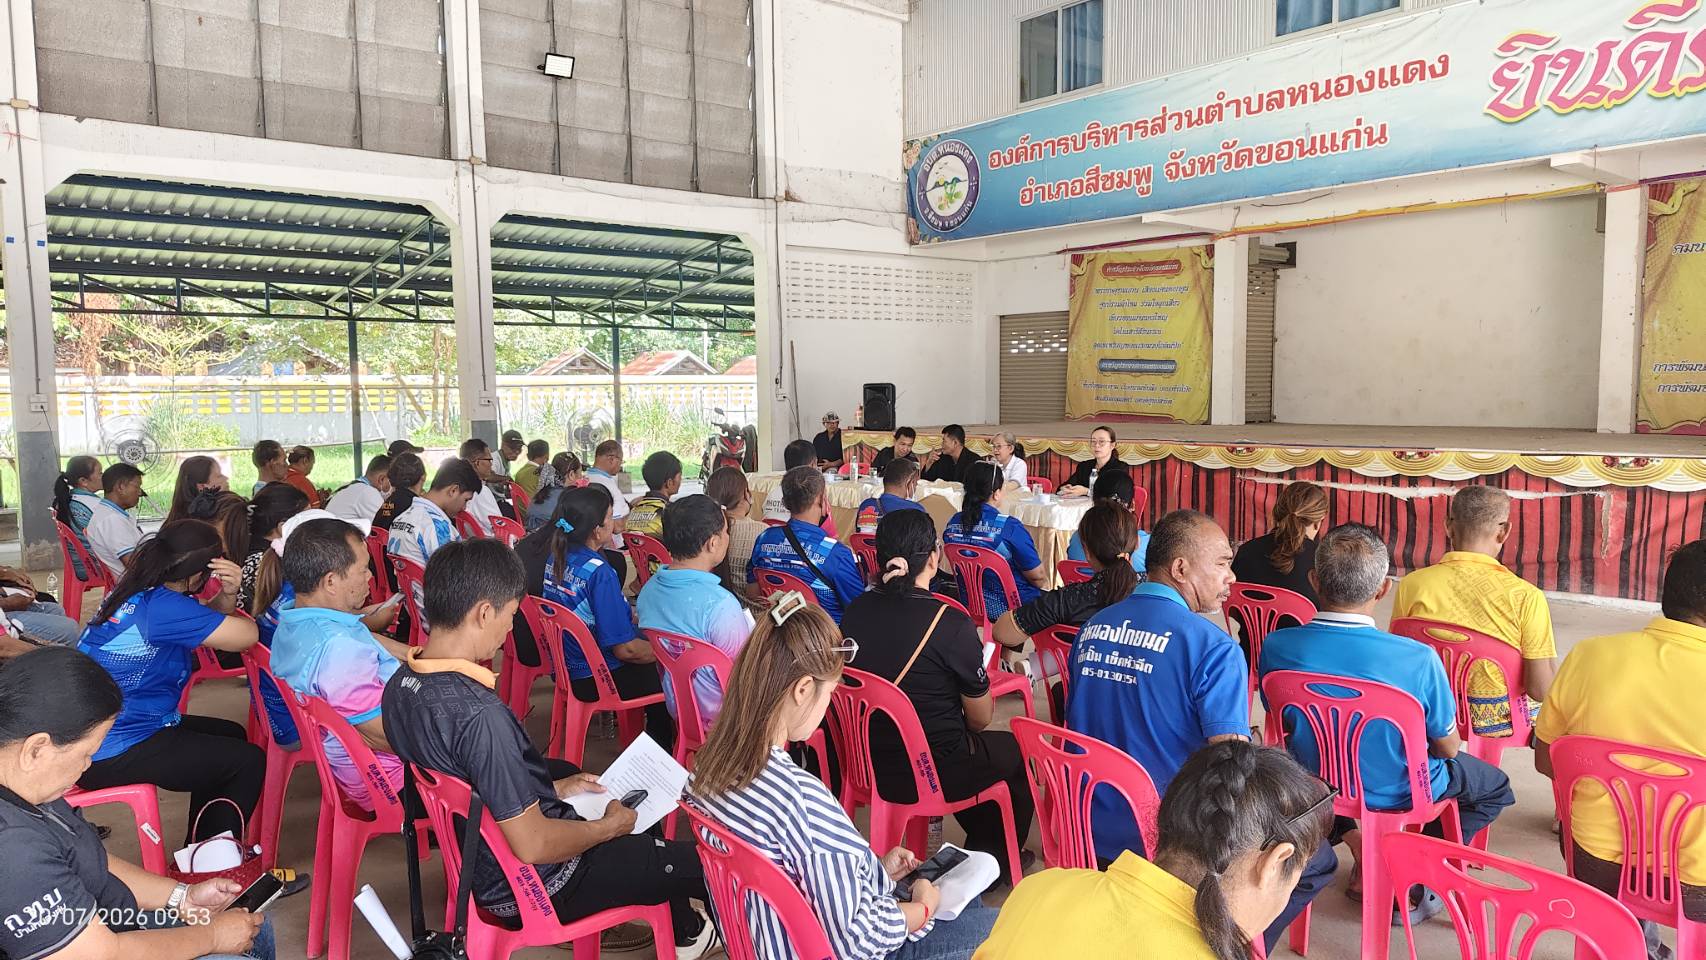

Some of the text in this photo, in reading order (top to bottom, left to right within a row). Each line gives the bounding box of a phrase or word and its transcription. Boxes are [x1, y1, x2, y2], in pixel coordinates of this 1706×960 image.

[989, 54, 1449, 168] องค์การบริหารส่วนตำบลหนองแดง
[1021, 118, 1388, 204] อำเภอสีชมพู จังหวัดขอนแก่น
